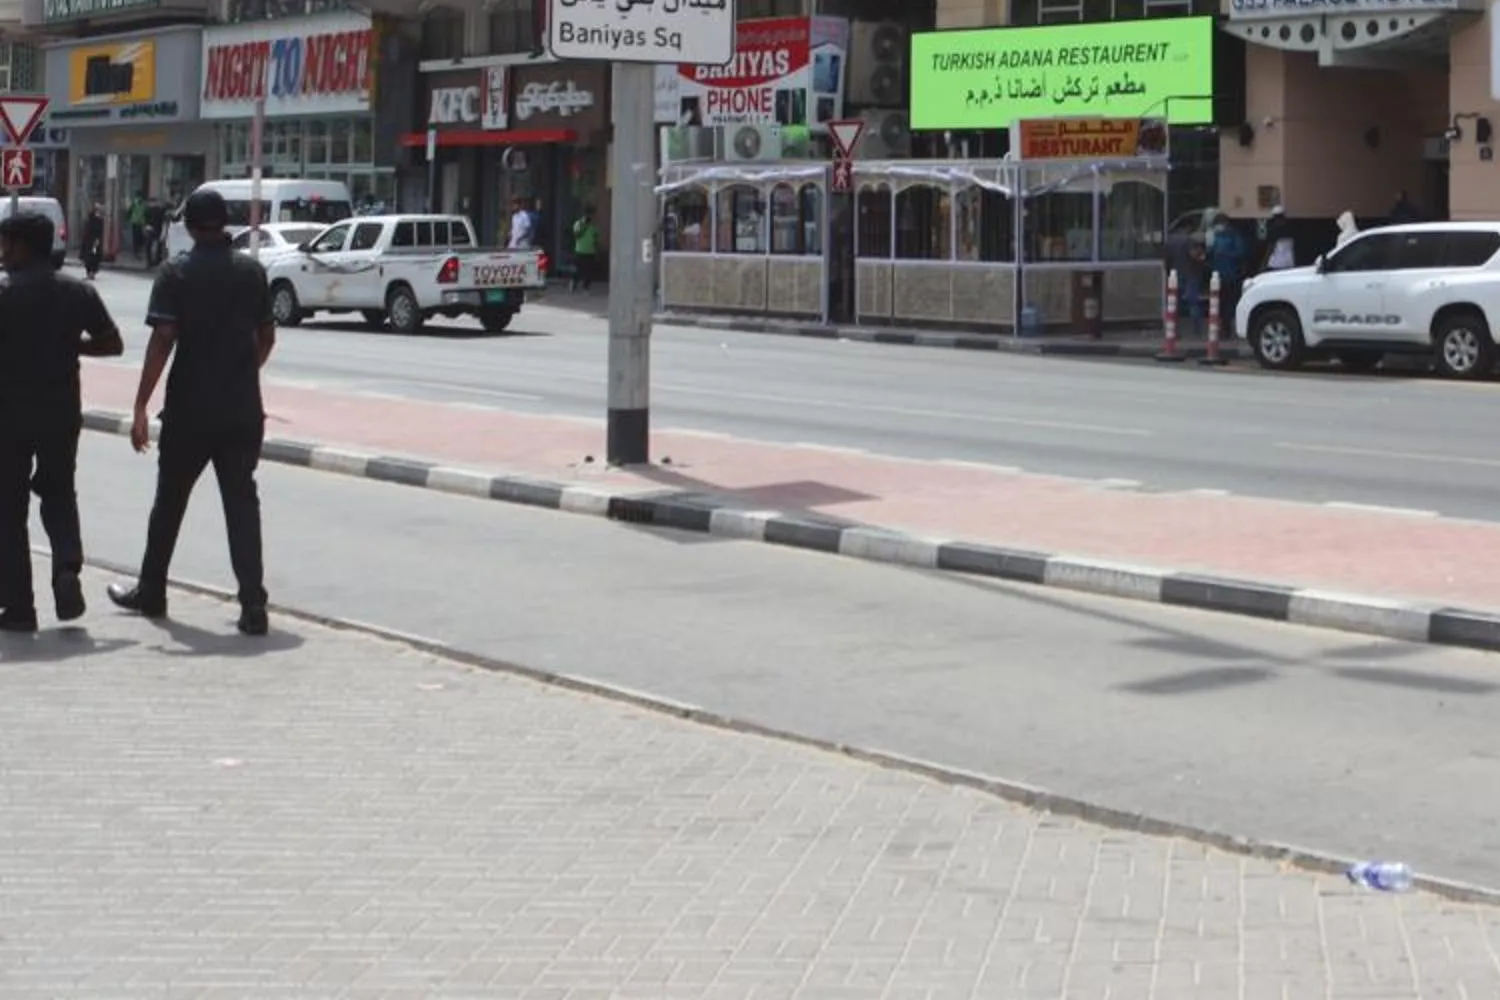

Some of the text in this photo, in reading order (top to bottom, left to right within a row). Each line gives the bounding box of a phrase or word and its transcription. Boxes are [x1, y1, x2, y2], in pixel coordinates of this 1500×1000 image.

[559, 22, 681, 50] Baniyas Sq
[204, 28, 375, 100] NIGHT TO NIGHT
[932, 51, 996, 71] TURKISH
[999, 48, 1053, 68] ADANA
[1057, 42, 1171, 66] RESTAURENT
[706, 87, 773, 114] PHONE
[1104, 71, 1146, 103] مطعم
[430, 86, 480, 124] KFC
[472, 263, 527, 277] TOYOTA
[1313, 313, 1402, 325] PRADO
